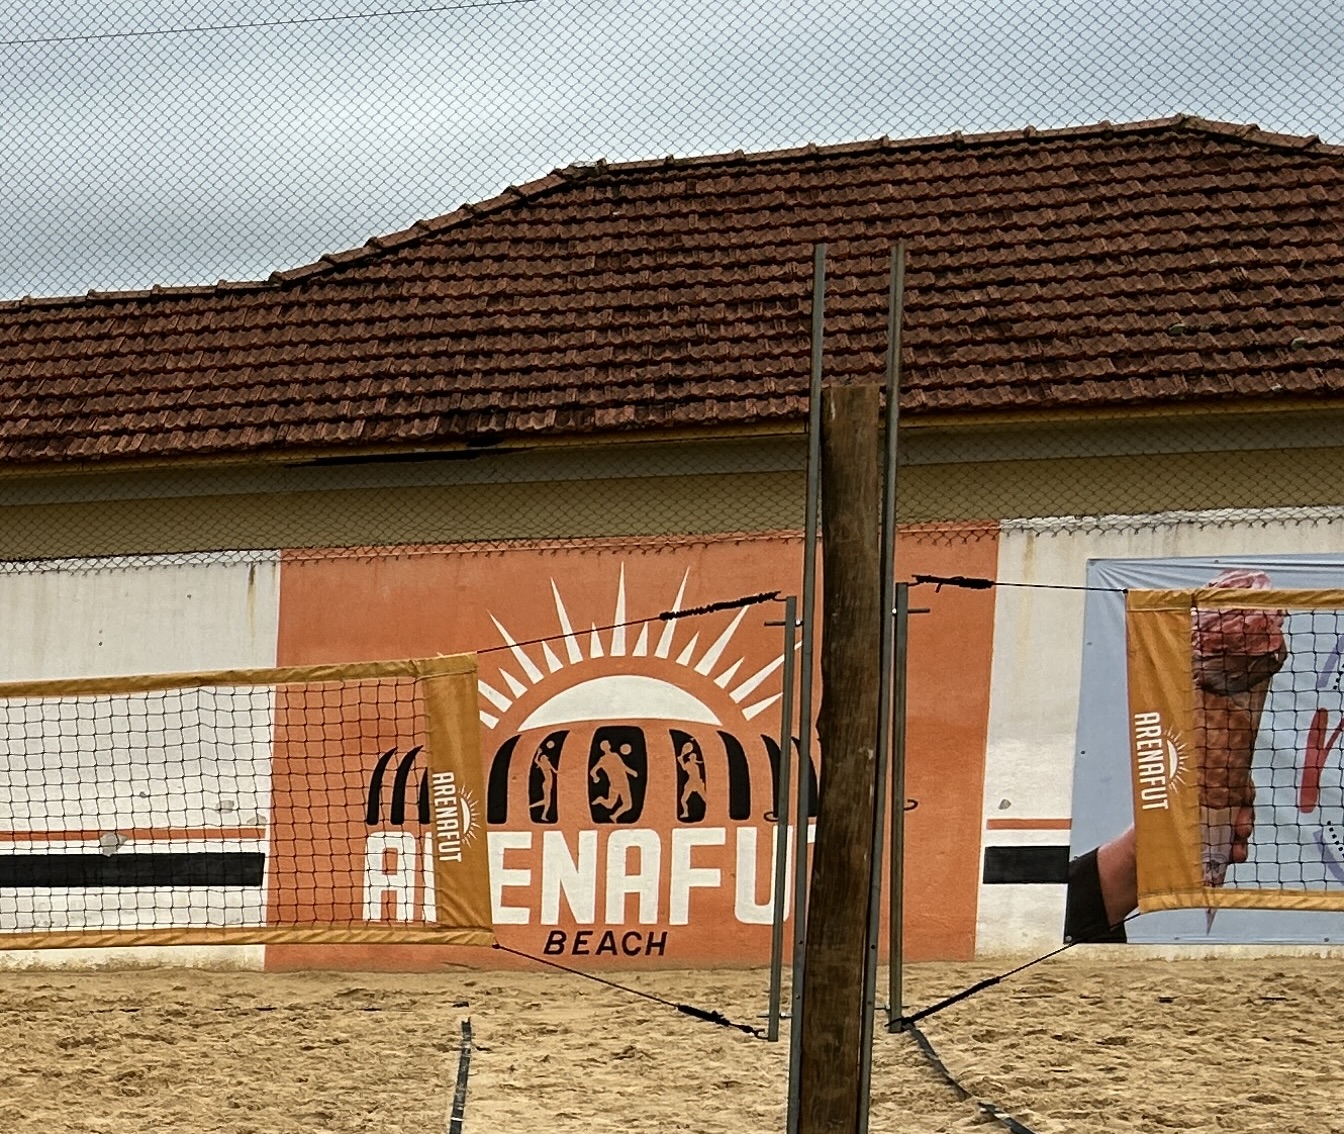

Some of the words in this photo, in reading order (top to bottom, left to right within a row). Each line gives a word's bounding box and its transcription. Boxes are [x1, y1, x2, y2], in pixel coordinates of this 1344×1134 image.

[1134, 711, 1169, 811] ARENAFUT
[431, 771, 463, 863] ARENAFUT
[362, 824, 817, 926] AENAFU
[542, 929, 669, 957] BEACH
